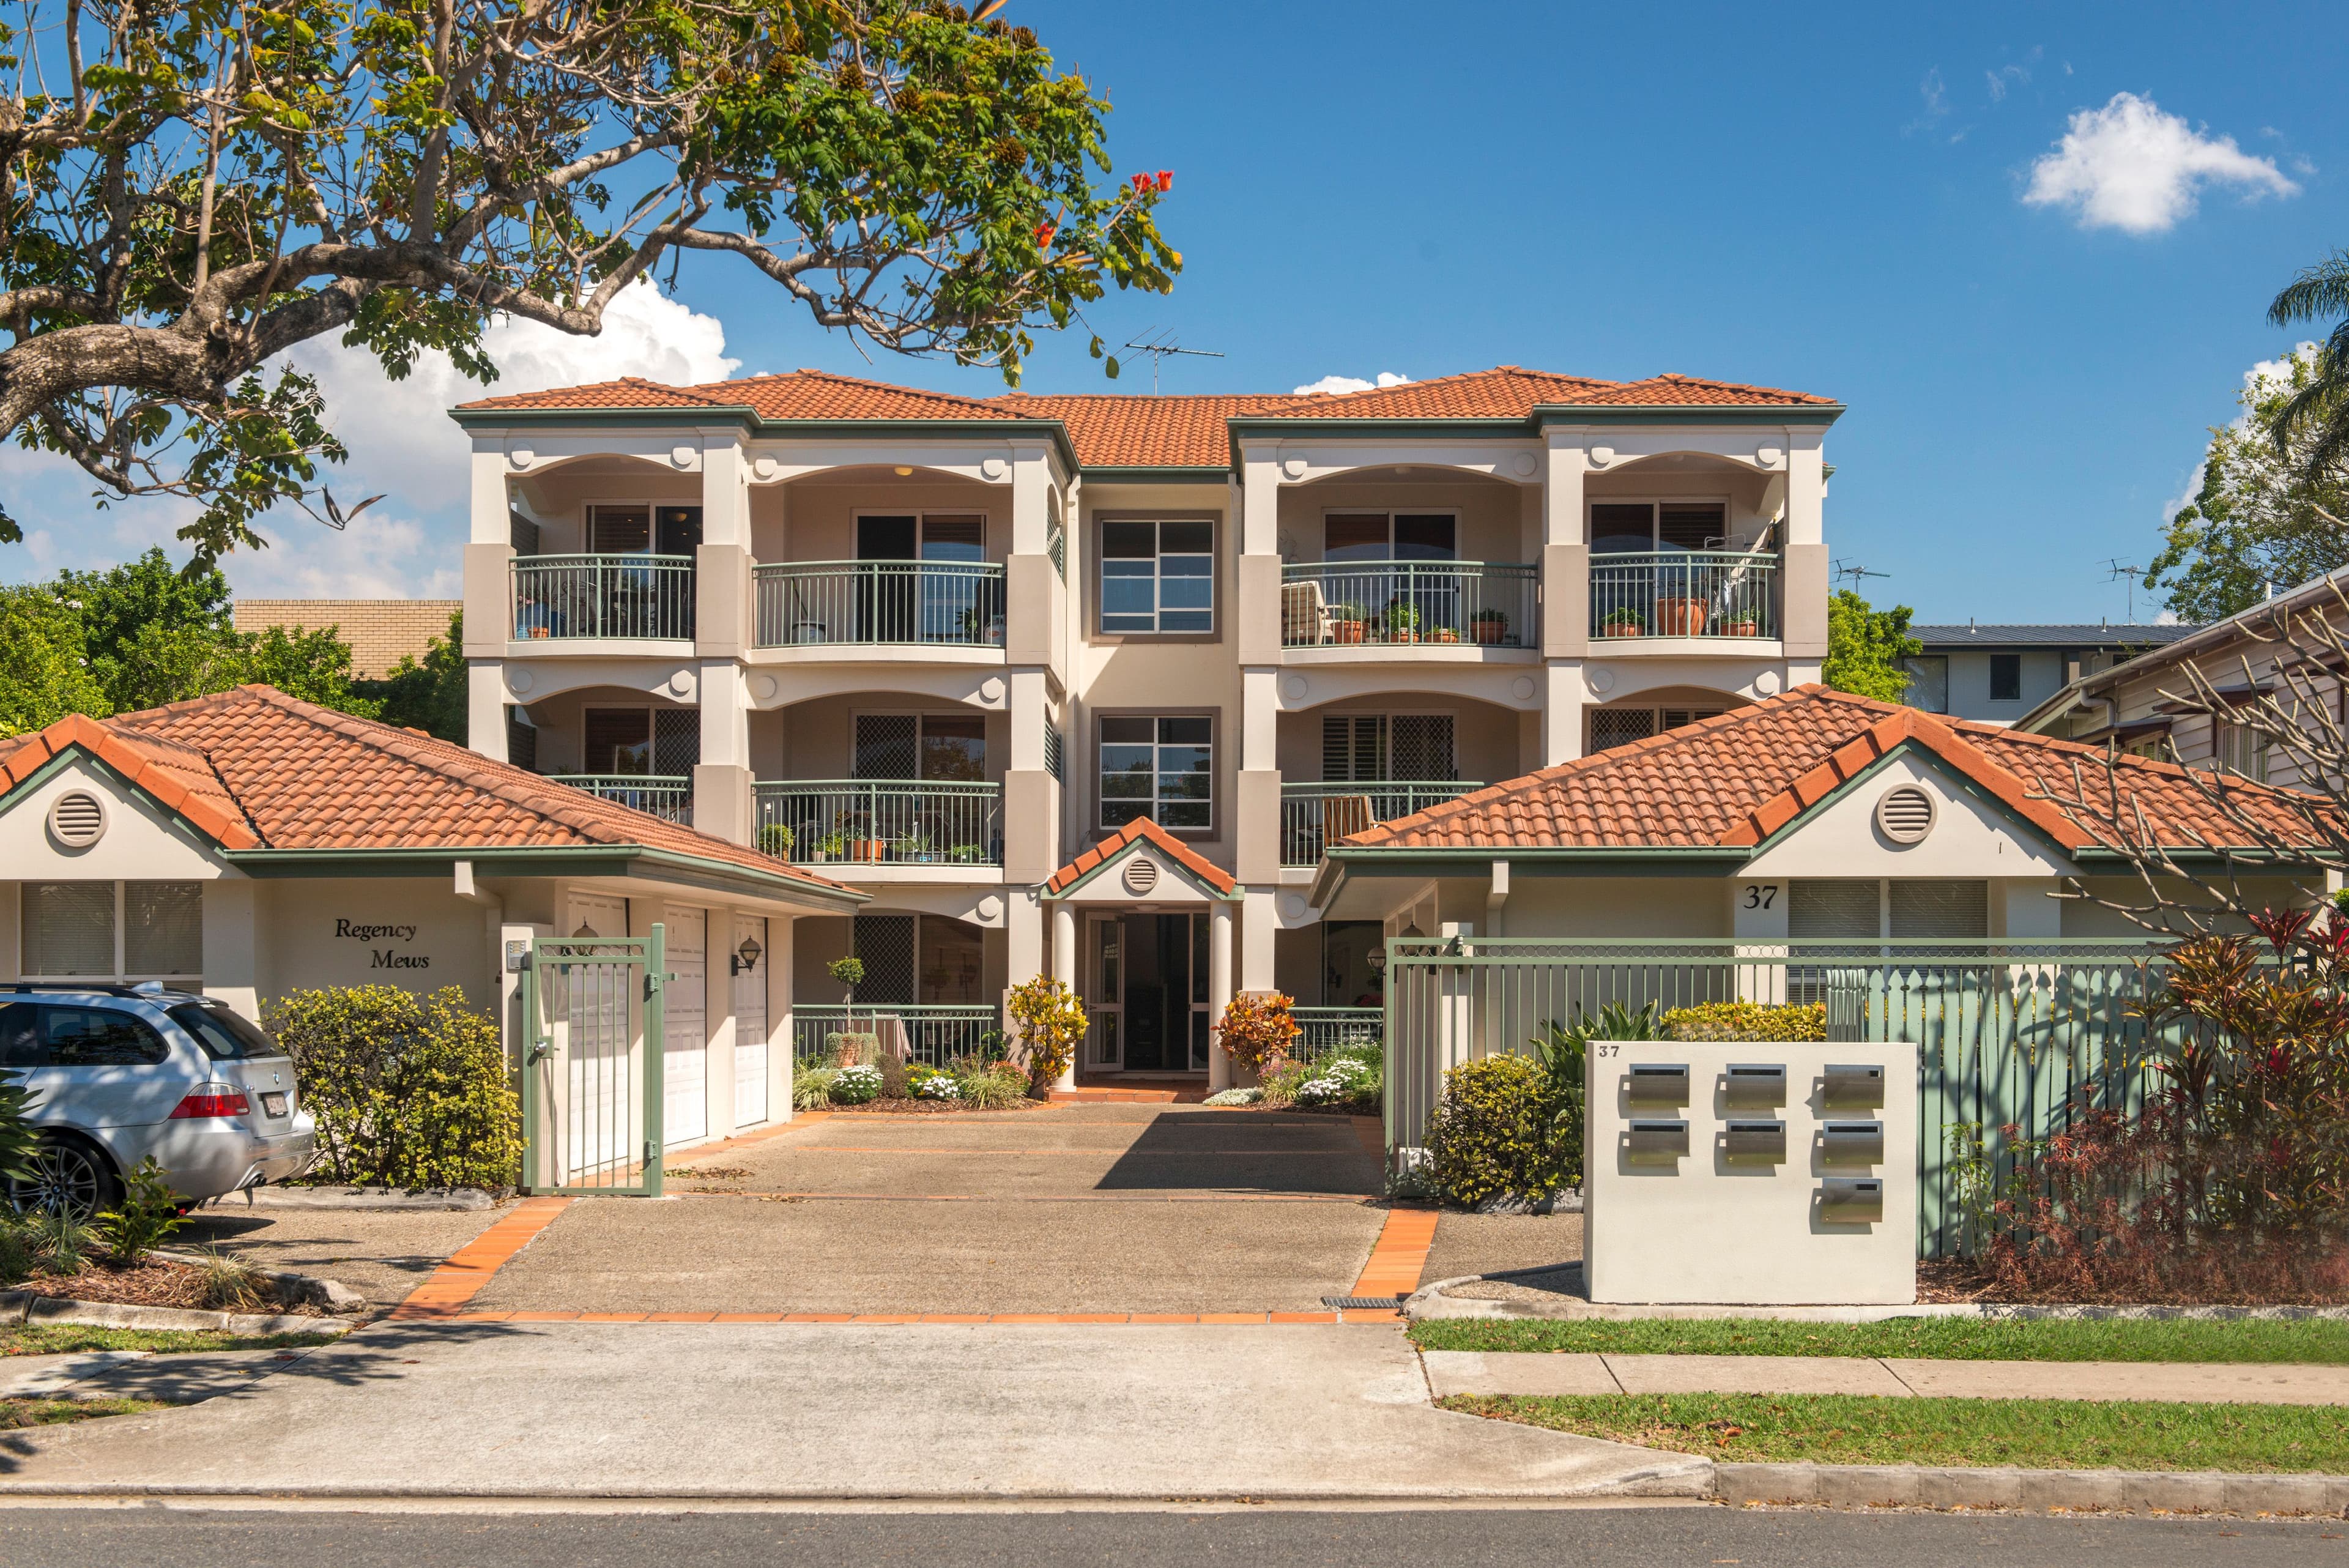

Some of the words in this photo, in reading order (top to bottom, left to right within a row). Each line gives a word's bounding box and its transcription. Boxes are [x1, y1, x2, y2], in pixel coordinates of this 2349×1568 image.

[1743, 885, 1778, 909] 37
[335, 919, 417, 942] Regency
[371, 949, 429, 968] Mews
[1599, 1046, 1619, 1057] 37
